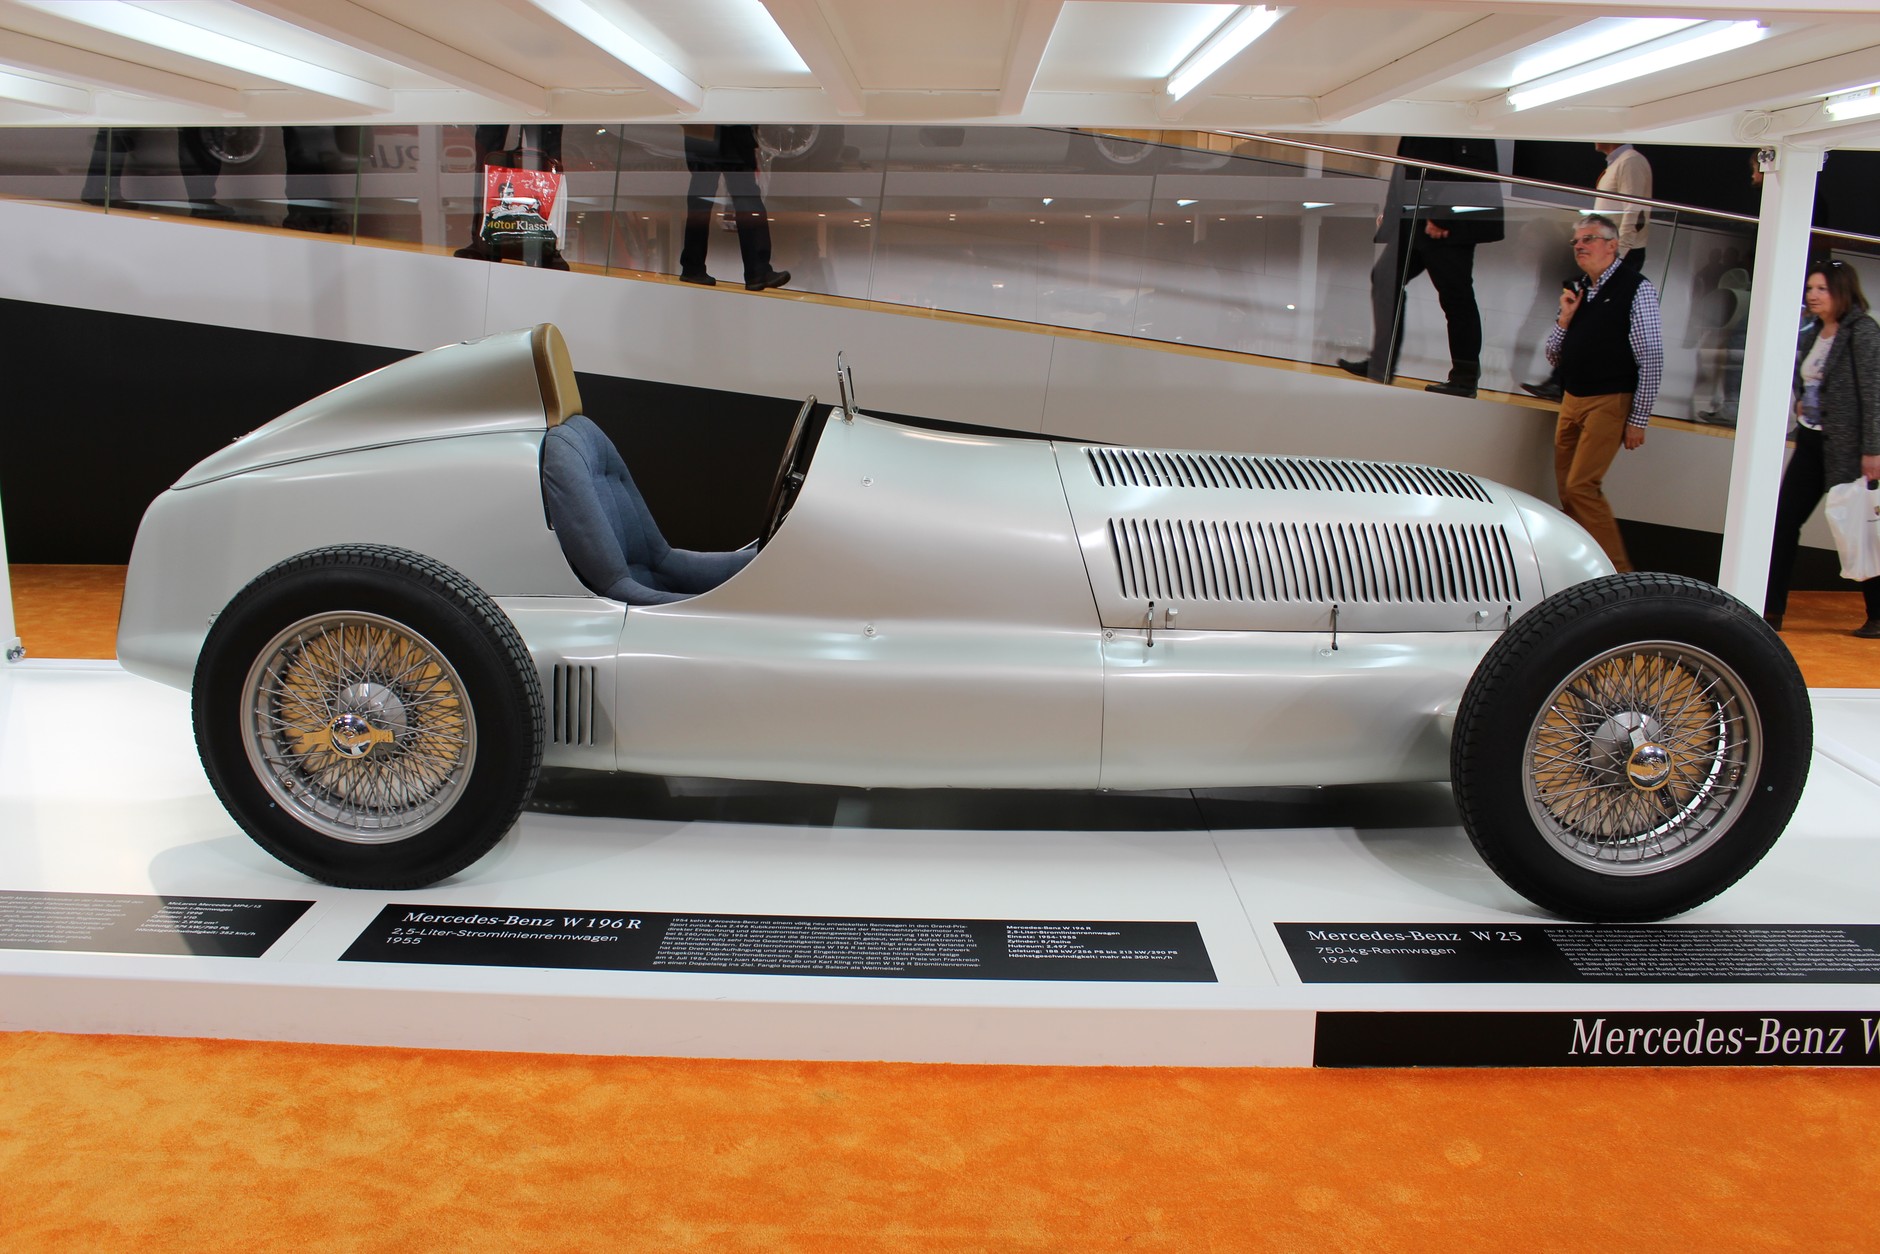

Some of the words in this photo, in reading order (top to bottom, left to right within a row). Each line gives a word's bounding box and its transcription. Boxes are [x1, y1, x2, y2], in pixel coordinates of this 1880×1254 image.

[402, 912, 554, 927] Mercedes-Benz
[563, 917, 584, 928] W
[586, 918, 624, 928] 196
[626, 919, 642, 930] R
[391, 928, 618, 942] 2,5-Liter-Stromlinienrennwagen
[1306, 930, 1462, 941] Mercedes-Benz
[1469, 930, 1490, 941] W
[1496, 931, 1522, 941] 25
[1315, 946, 1456, 956] 750-kg-Rennwagen
[1567, 1018, 1846, 1055] Mercedes-Benz
